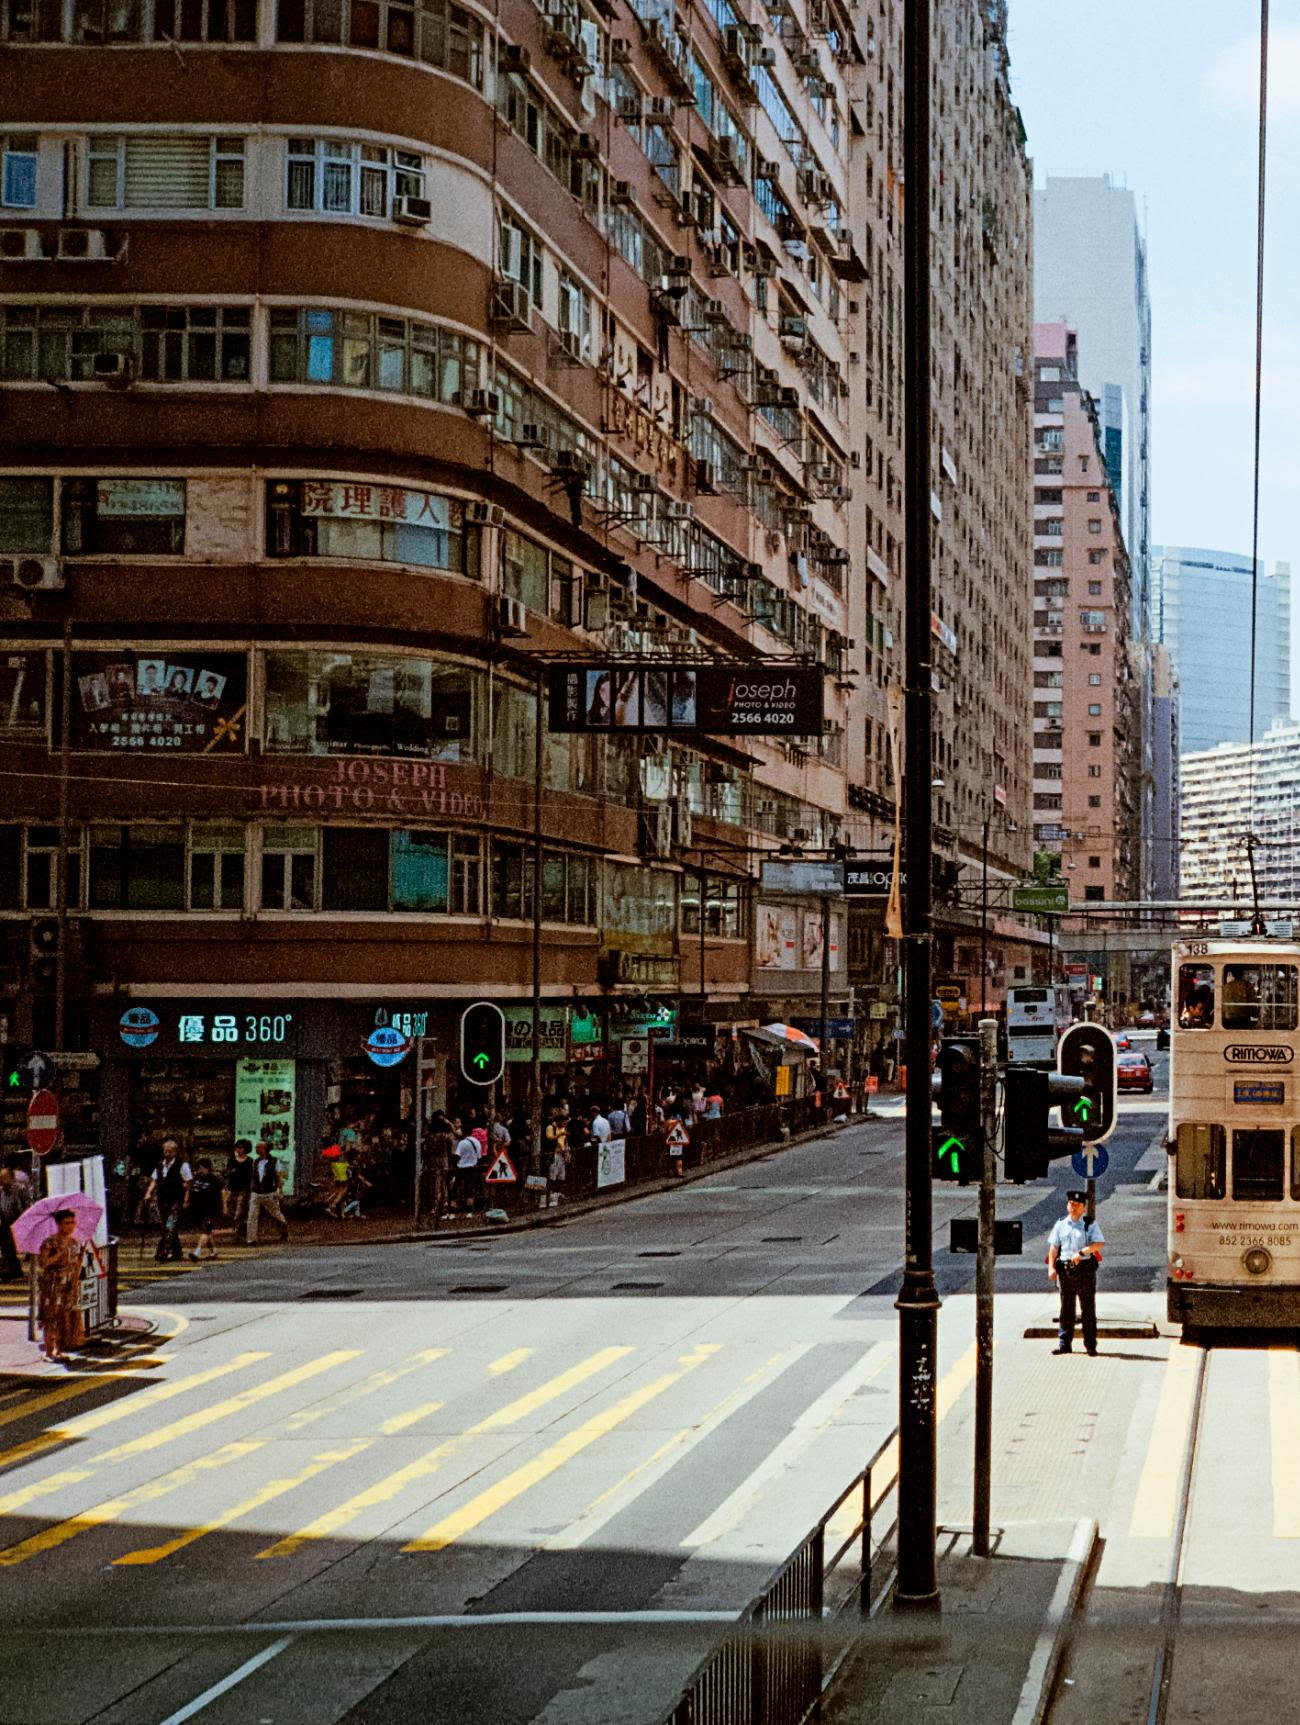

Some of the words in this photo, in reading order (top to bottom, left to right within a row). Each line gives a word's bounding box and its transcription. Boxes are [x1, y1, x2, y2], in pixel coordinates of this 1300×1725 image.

[734, 701, 761, 709] PHOTO
[771, 701, 796, 709] VIDEO
[731, 713, 761, 724] 2566
[764, 713, 794, 724] 4020
[111, 735, 145, 746] 2566
[149, 735, 182, 746] 4020
[336, 760, 447, 789] JOSEPH
[261, 784, 374, 809] PHOTO
[387, 788, 404, 810] &
[422, 790, 487, 820] VIDEO
[1188, 944, 1208, 956] 138
[1232, 1048, 1287, 1060] RIMOWA
[1211, 1221, 1299, 1231] www.rimowa.com
[1219, 1236, 1237, 1246] 852
[1240, 1236, 1265, 1247] 2366
[1267, 1236, 1292, 1247] 8085
